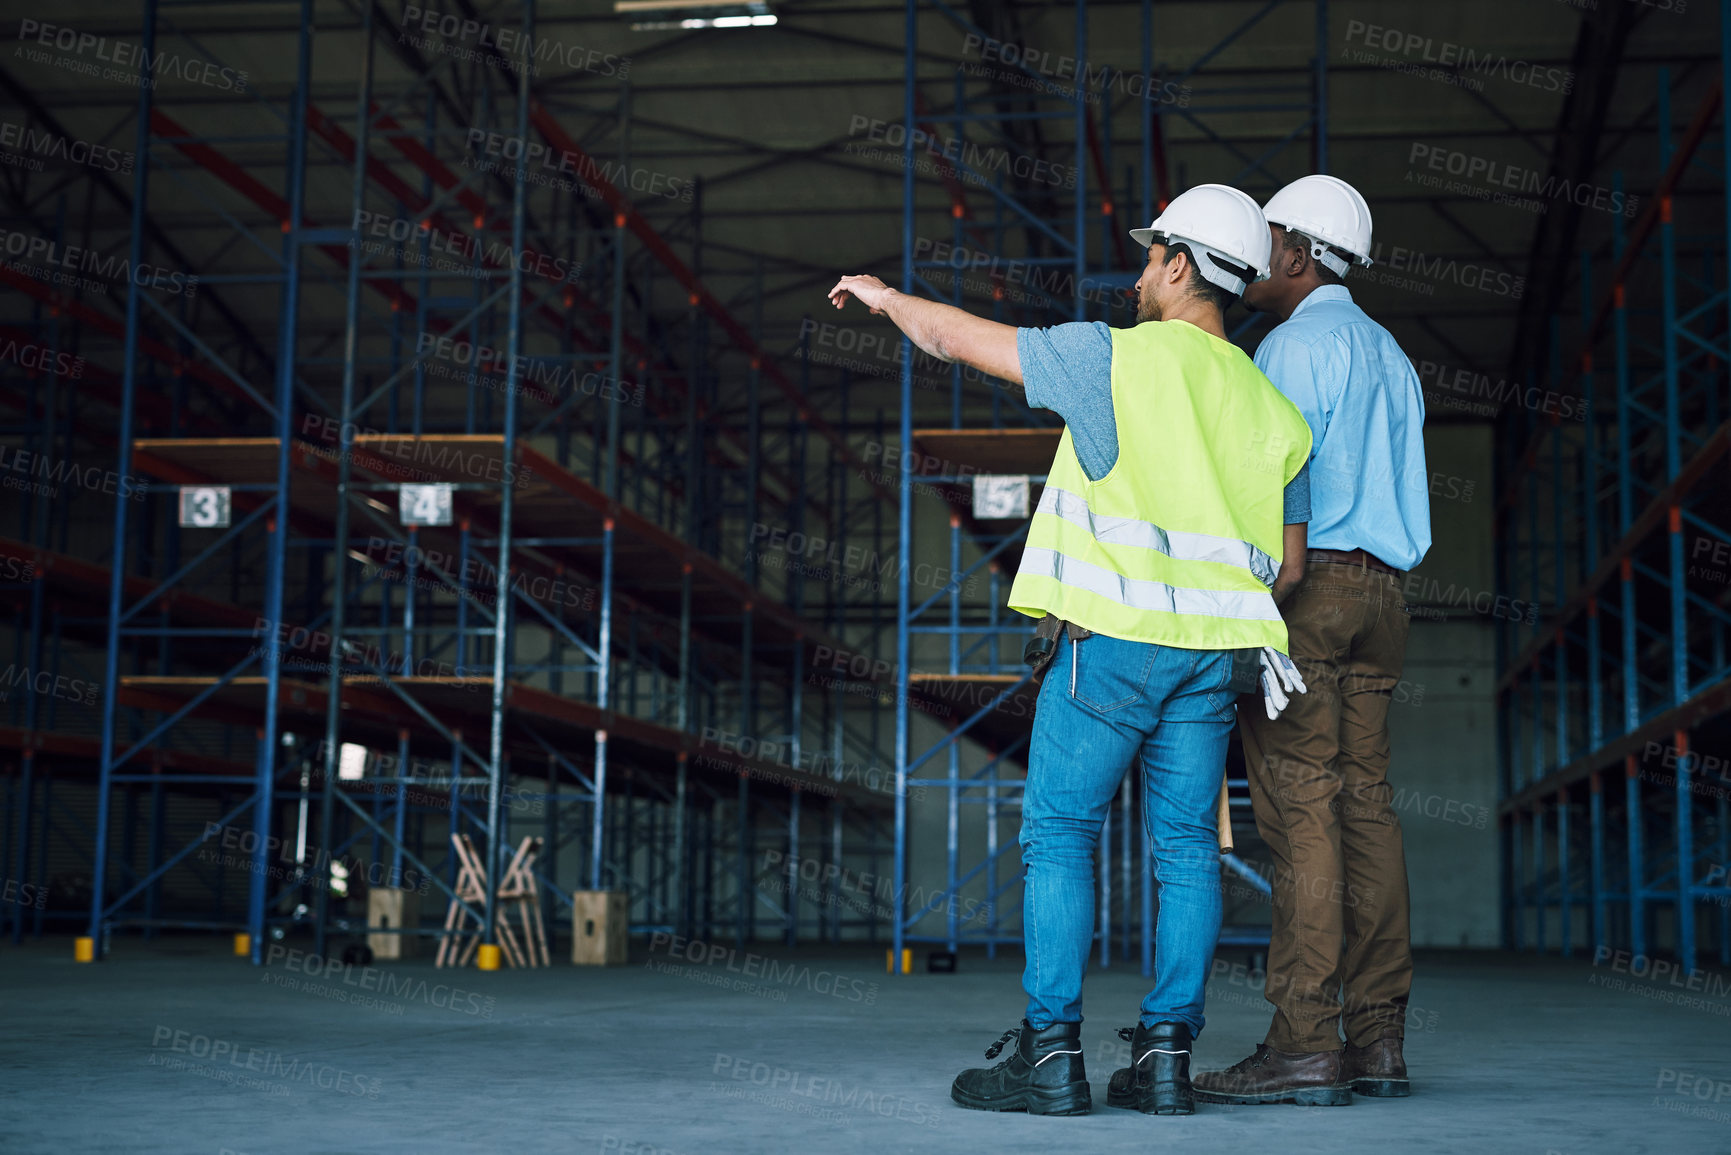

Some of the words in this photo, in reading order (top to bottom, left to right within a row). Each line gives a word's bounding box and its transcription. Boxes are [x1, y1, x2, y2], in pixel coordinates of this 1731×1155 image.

[193, 488, 219, 527] 3
[412, 485, 440, 525] 4
[984, 476, 1017, 518] 5
